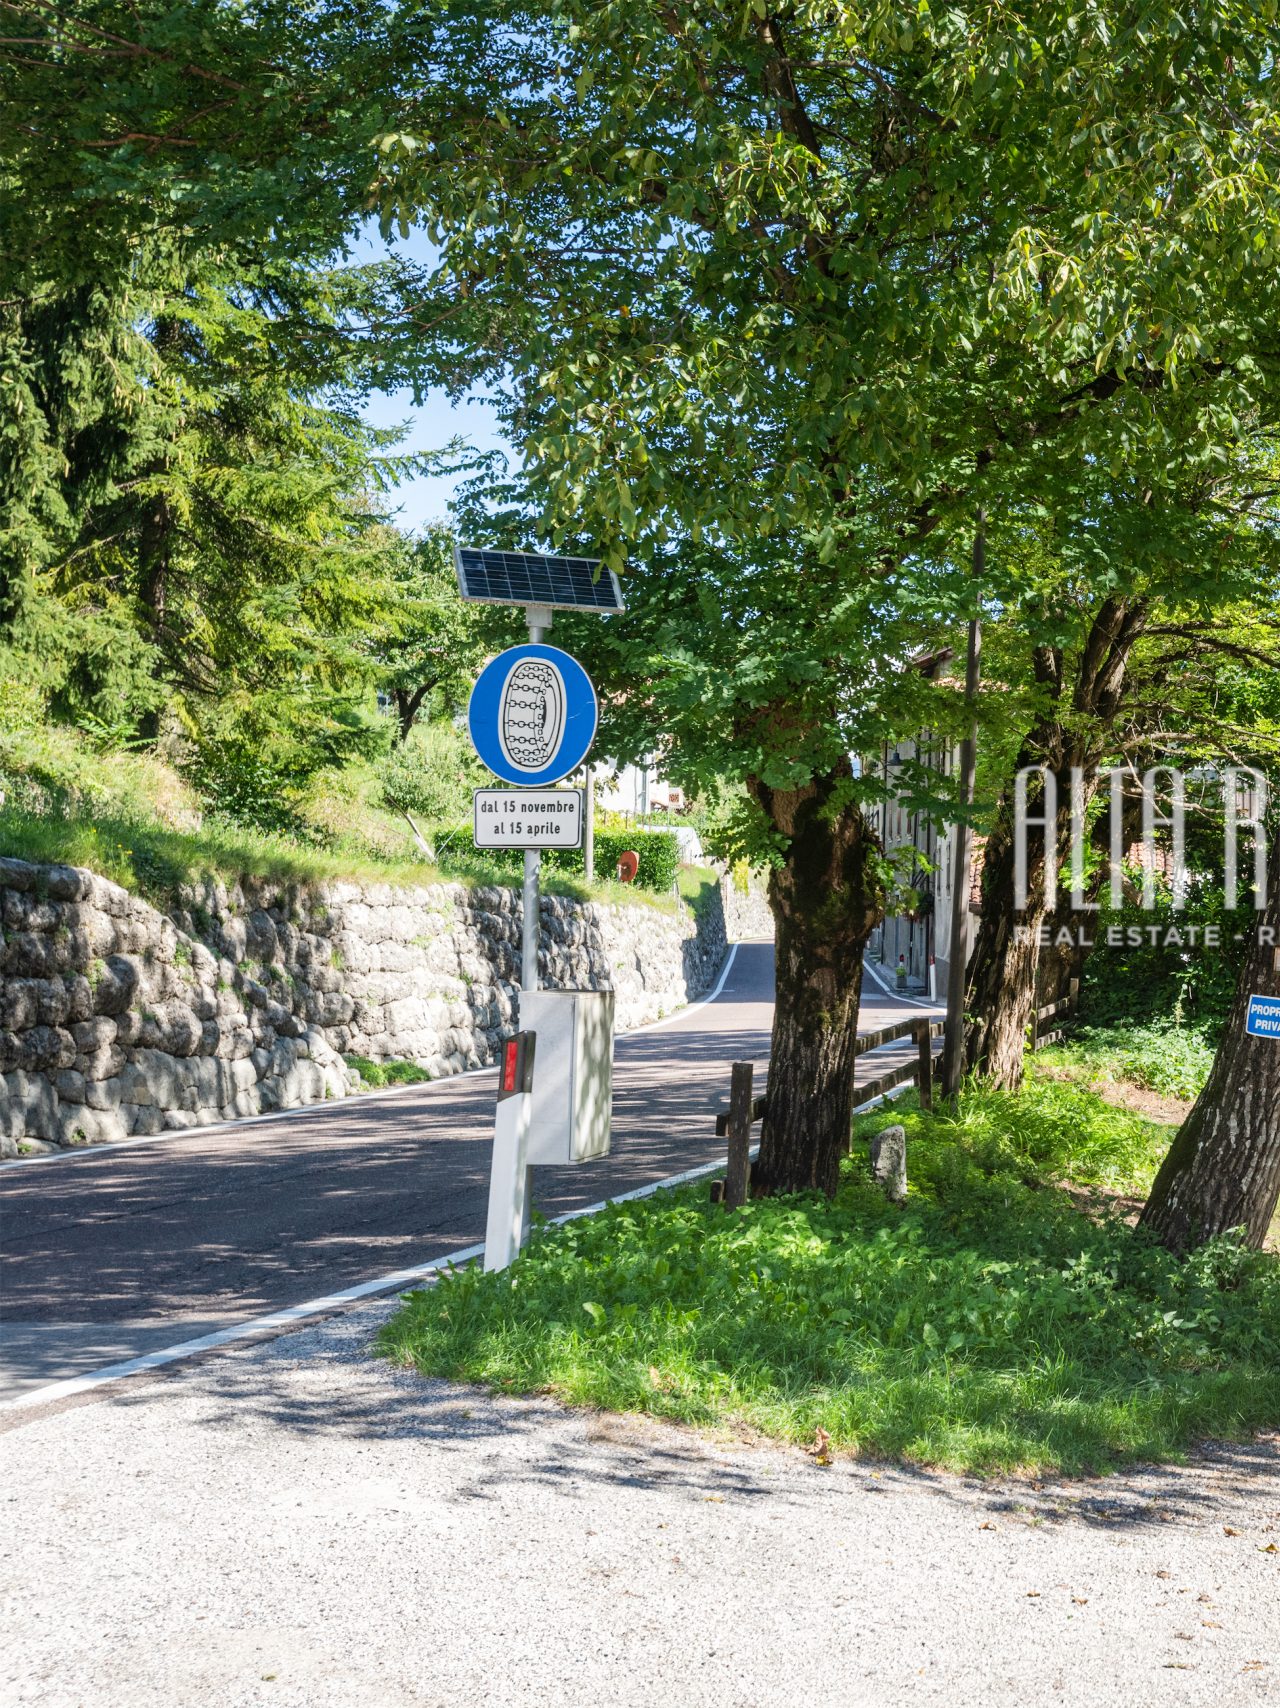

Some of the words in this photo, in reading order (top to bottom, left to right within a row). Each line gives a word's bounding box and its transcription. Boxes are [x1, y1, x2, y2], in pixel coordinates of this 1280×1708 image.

[481, 800, 498, 813] dal
[503, 800, 516, 813] 15
[521, 800, 574, 813] novembre
[494, 822, 505, 834] al
[510, 822, 522, 834] 15
[527, 822, 561, 837] aprile
